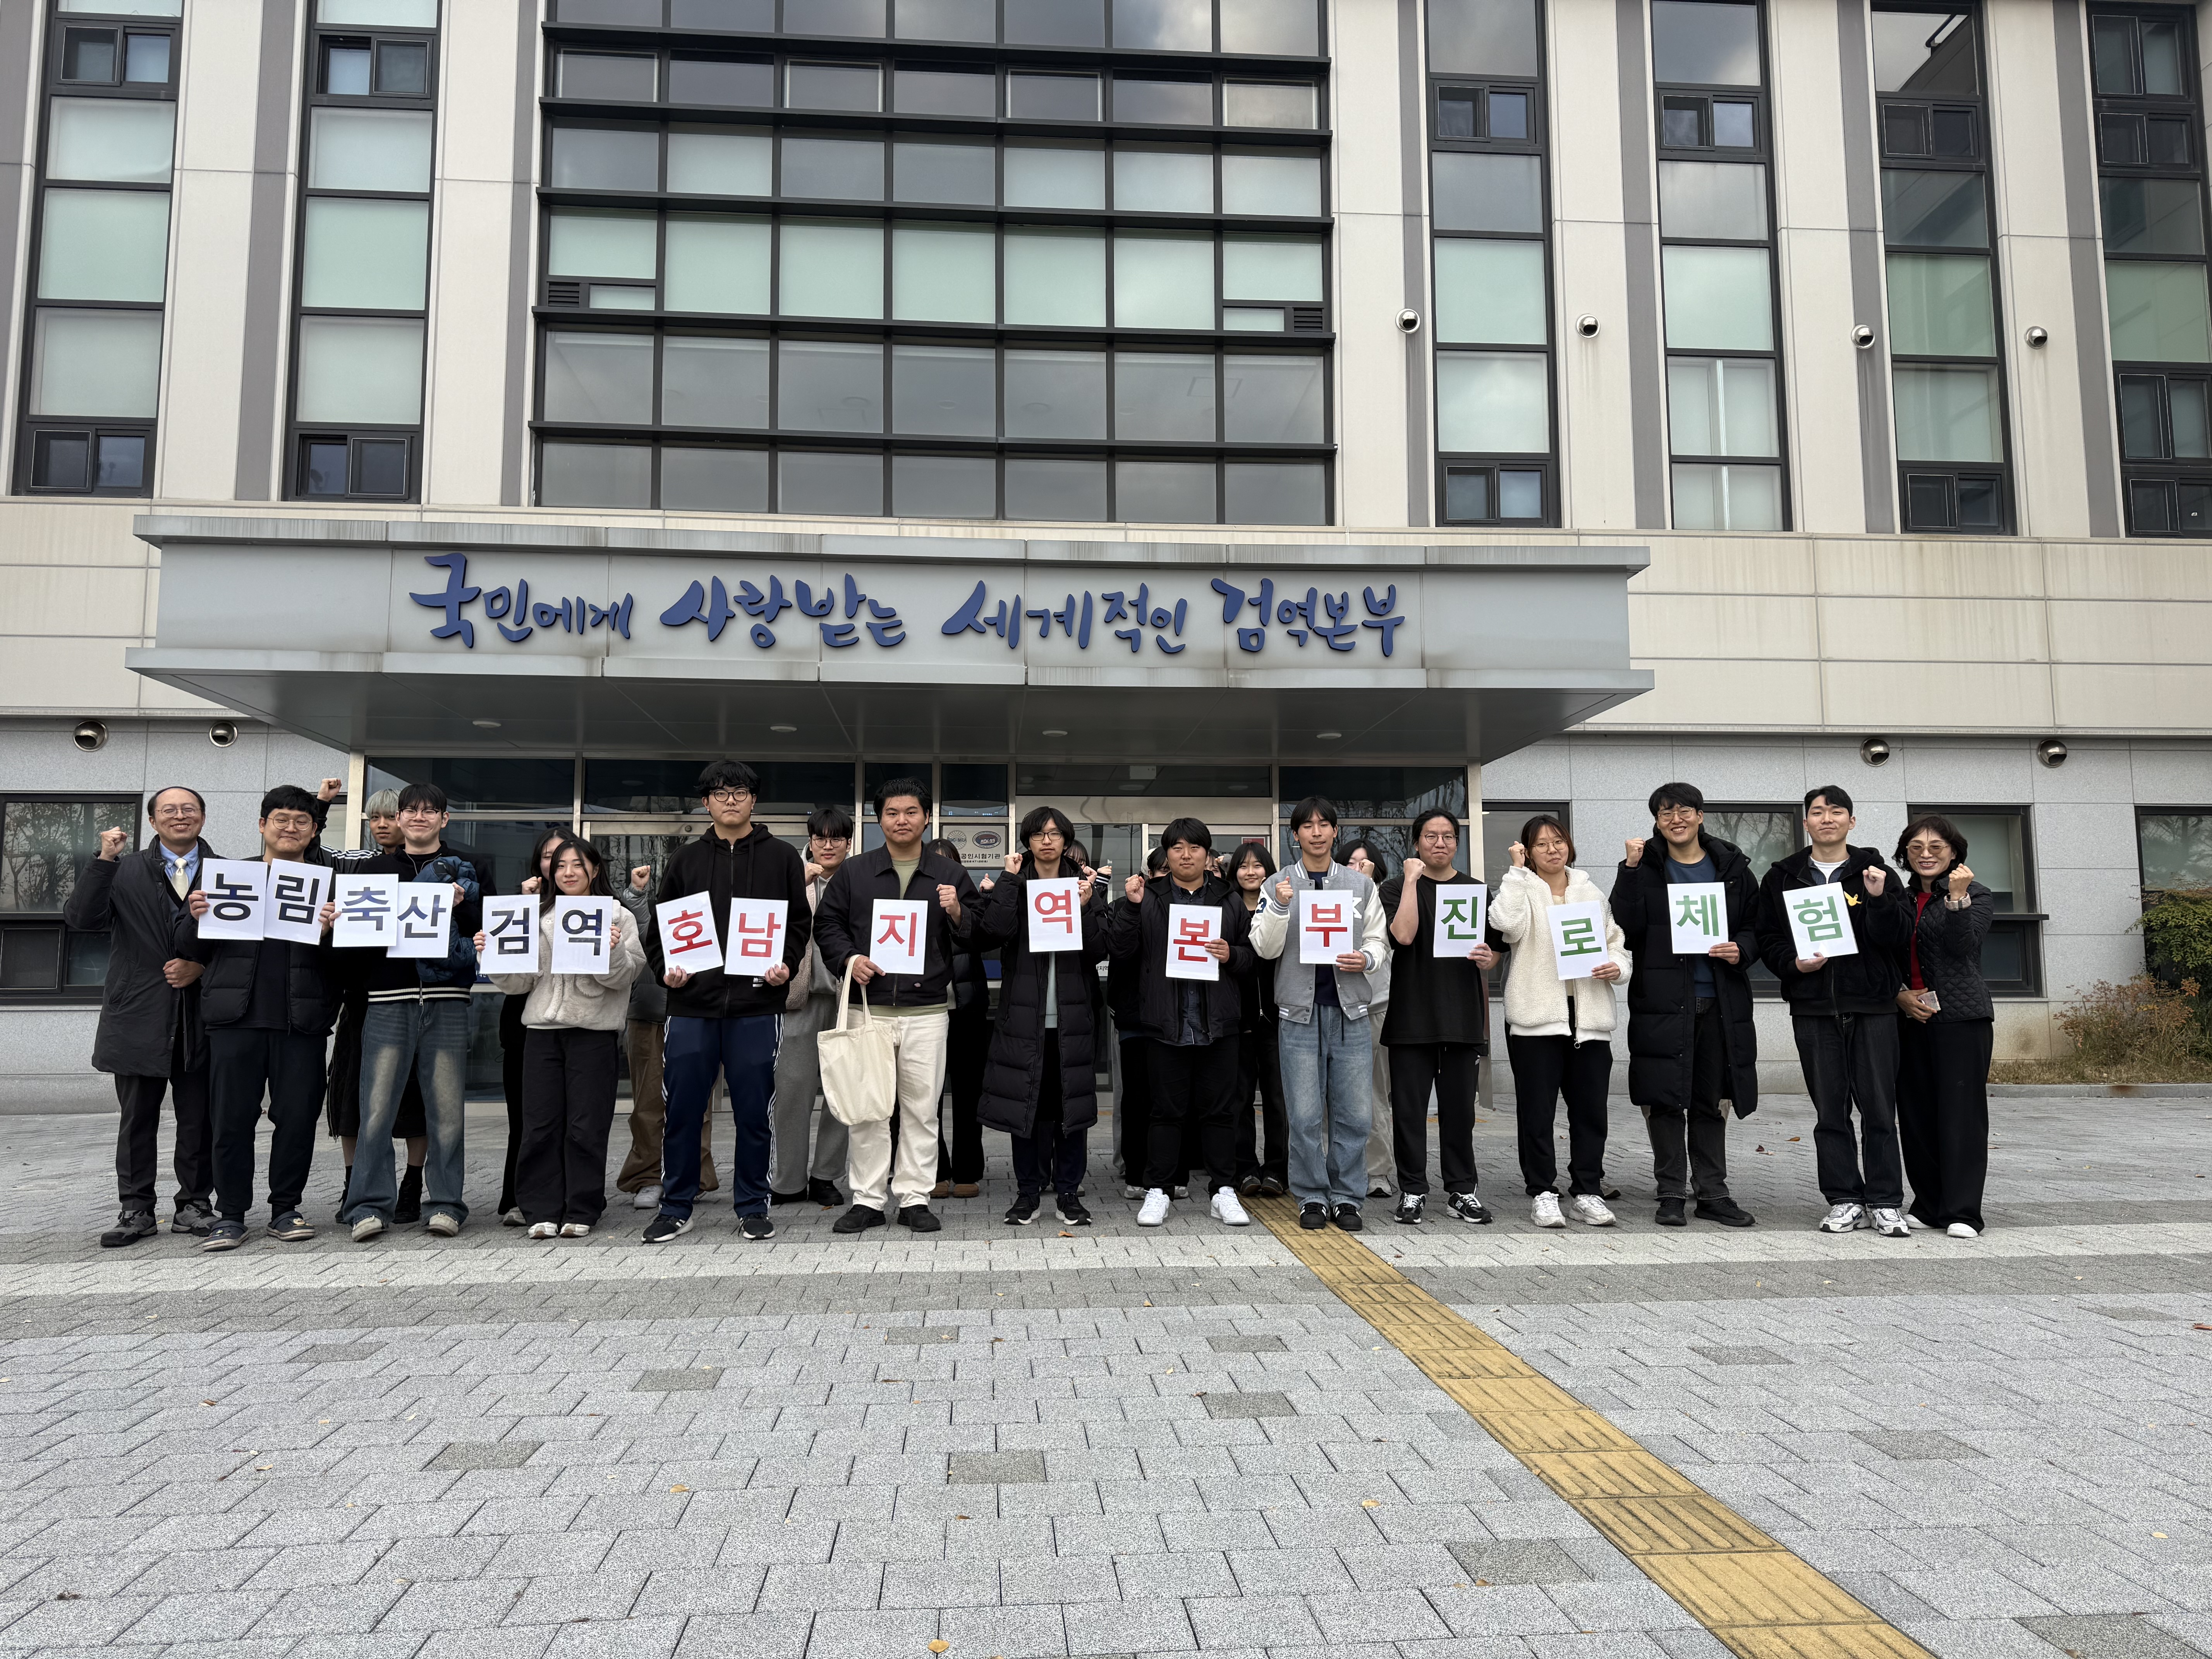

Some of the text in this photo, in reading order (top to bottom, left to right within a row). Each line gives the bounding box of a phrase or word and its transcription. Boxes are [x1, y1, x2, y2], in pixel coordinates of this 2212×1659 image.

[410, 553, 1405, 656] 국민에게 사랑받는 세계적인 검역본부
[207, 874, 258, 921] 농
[275, 875, 319, 924] 림
[342, 887, 390, 931] 축
[398, 895, 446, 938] 산
[1034, 890, 1072, 933] 역
[1440, 896, 1478, 940] 진
[1676, 894, 1719, 936] 체
[1793, 896, 1844, 942] 험
[489, 908, 529, 954] 검
[562, 909, 602, 955] 역
[668, 911, 712, 954] 호
[739, 913, 781, 957] 남
[878, 913, 917, 956] 지
[1173, 918, 1211, 962] 본
[1306, 904, 1347, 947] 부
[1560, 917, 1602, 957] 로
